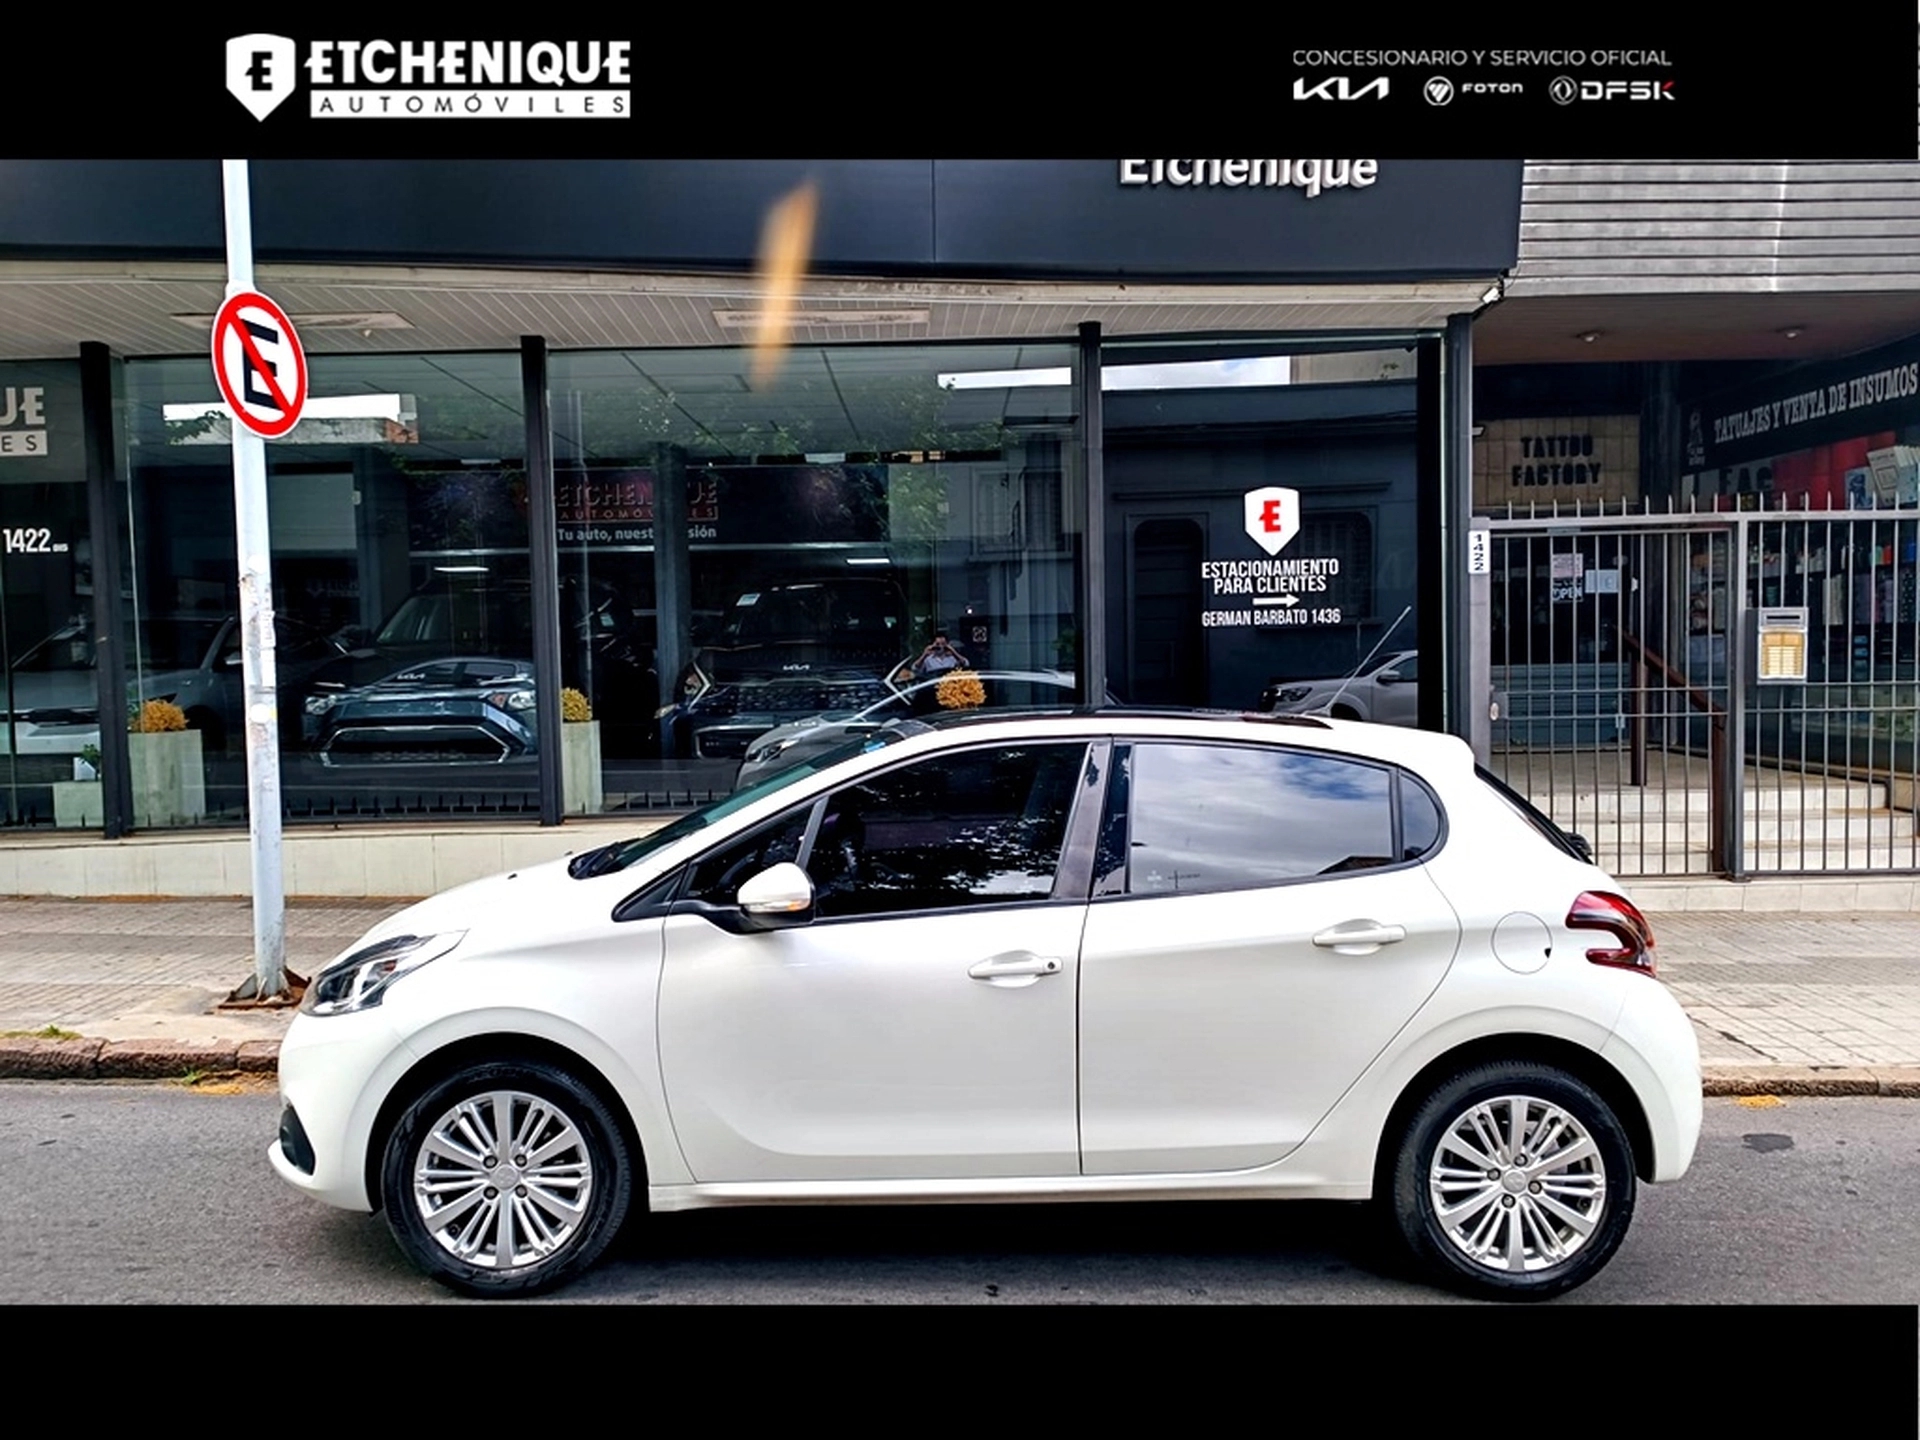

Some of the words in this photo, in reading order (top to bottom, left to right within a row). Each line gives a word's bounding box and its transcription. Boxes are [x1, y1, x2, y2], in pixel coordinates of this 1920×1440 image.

[1714, 404, 1771, 443] TATUAJES
[1772, 400, 1783, 429] Y
[1782, 388, 1826, 425] VENTA
[1828, 382, 1847, 414] DE
[1849, 362, 1918, 409] INSUMOS
[1521, 435, 1593, 458] TATTOO
[1512, 463, 1601, 486] FACTORY
[3, 528, 51, 553] 1422
[557, 528, 574, 541] Tu
[576, 528, 612, 543] auto,
[1202, 559, 1339, 579] ESTACIONAMIENTO
[1214, 577, 1253, 595] PARA
[1256, 575, 1327, 593] CLIENTES
[1202, 610, 1251, 627] GERMAN
[1254, 609, 1308, 625] BARBATO
[1311, 608, 1341, 624] 1436
